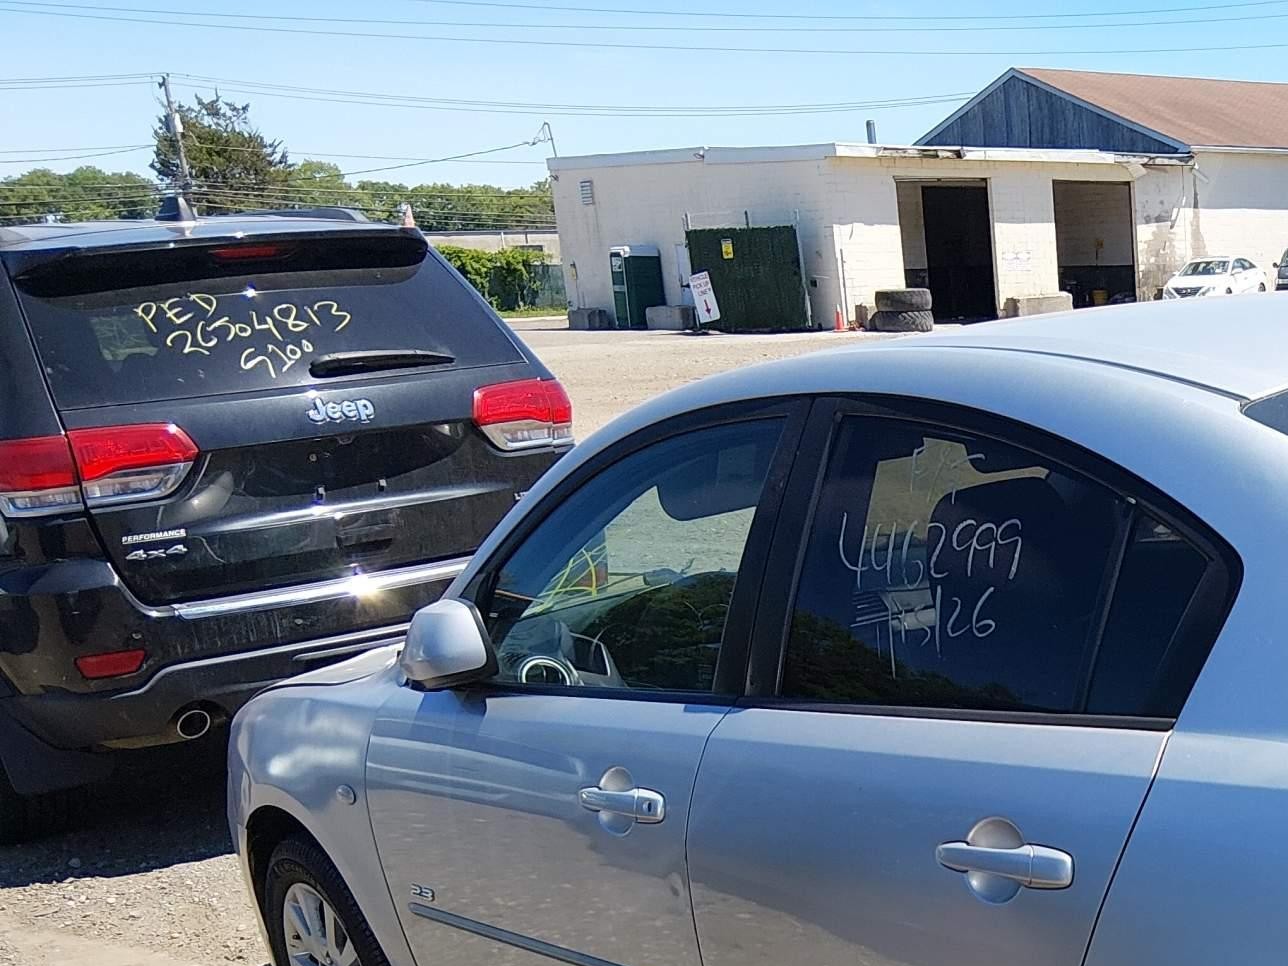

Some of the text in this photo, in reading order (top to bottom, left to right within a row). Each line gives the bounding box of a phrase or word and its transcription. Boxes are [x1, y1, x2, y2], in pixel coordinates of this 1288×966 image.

[133, 293, 217, 333] PED
[306, 397, 375, 424] Jeep
[121, 528, 187, 544] PERFORMANCE
[125, 544, 188, 560] 4x4
